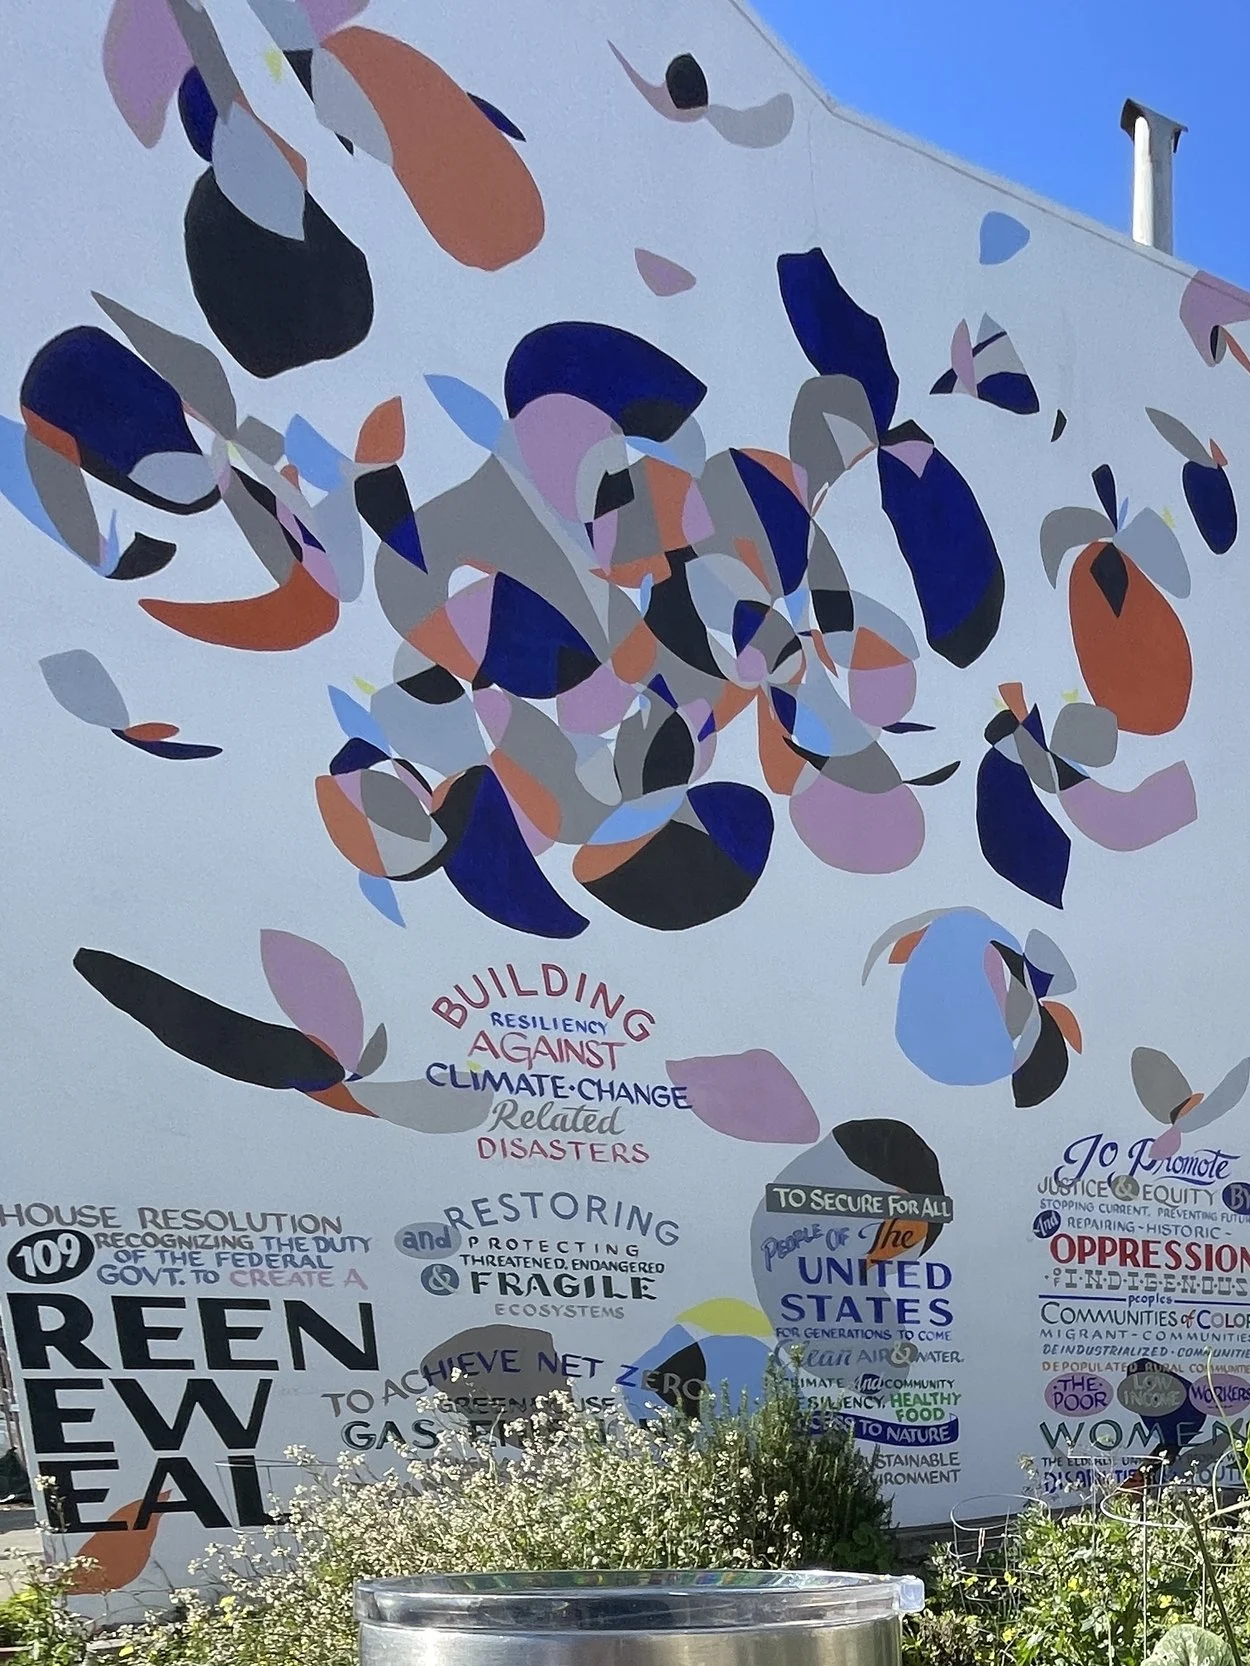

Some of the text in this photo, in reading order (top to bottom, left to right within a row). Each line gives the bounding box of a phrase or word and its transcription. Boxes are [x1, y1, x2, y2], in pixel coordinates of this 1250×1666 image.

[431, 963, 656, 1043] BUILDING
[490, 1011, 608, 1036] RESILIENCY
[467, 1030, 627, 1071] AGAINST
[487, 1099, 626, 1135] Related
[476, 1136, 650, 1164] DISASTERS
[772, 1188, 950, 1217] TO SECURE FOR ALL
[1037, 1176, 1109, 1198] JUSTICE
[1142, 1184, 1218, 1207] EQUITY
[0, 1202, 343, 1236] HOUSE RESOLUTION
[443, 1191, 680, 1247] RESTORING
[1040, 1198, 1094, 1212] STOPPING
[1158, 1208, 1217, 1221] PREVENTING
[402, 1226, 452, 1252] and
[858, 1218, 917, 1254] The
[1068, 1217, 1221, 1239] REPAIRING HISTORIC
[93, 1231, 372, 1254] RECOGNIZING THE DUTY
[468, 1236, 639, 1257] PROTECTING
[16, 1232, 82, 1278] 109
[113, 1250, 334, 1270] OF THE FEDERAL
[571, 1258, 665, 1274] ENDANGERED
[97, 1264, 368, 1290] GOVT. TO CREATE A
[798, 1256, 952, 1290] UNITED
[470, 1271, 657, 1300] FRAGILE
[494, 1303, 625, 1319] ECOSYSTEMS
[780, 1293, 954, 1327] STATES
[1041, 1302, 1177, 1327] COMMUNITIES
[1181, 1309, 1196, 1325] of
[776, 1327, 952, 1341] FOR GENERATIONS TO COME
[1040, 1329, 1128, 1340] MIGRANT
[857, 1347, 888, 1363] AIR
[1043, 1344, 1167, 1357] DEINDUSTRIALIZED
[1042, 1362, 1138, 1372] DEPOPULATED
[1145, 1362, 1184, 1373] RURAL
[321, 1349, 703, 1418] TO ACHIEVE NET ZERO
[885, 1379, 955, 1389] COMMUNITY
[1058, 1376, 1098, 1391] THE
[1134, 1374, 1172, 1391] LOW
[890, 1392, 961, 1408] HEALTHY
[1054, 1392, 1108, 1411] POOR
[1124, 1391, 1180, 1408] INCOME
[896, 1408, 945, 1422] FOOD
[340, 1419, 440, 1451] GAS
[859, 1420, 882, 1436] TO
[886, 1425, 951, 1443] NATURE
[1040, 1419, 1250, 1451] WOMEN
[1042, 1457, 1063, 1467] THE
